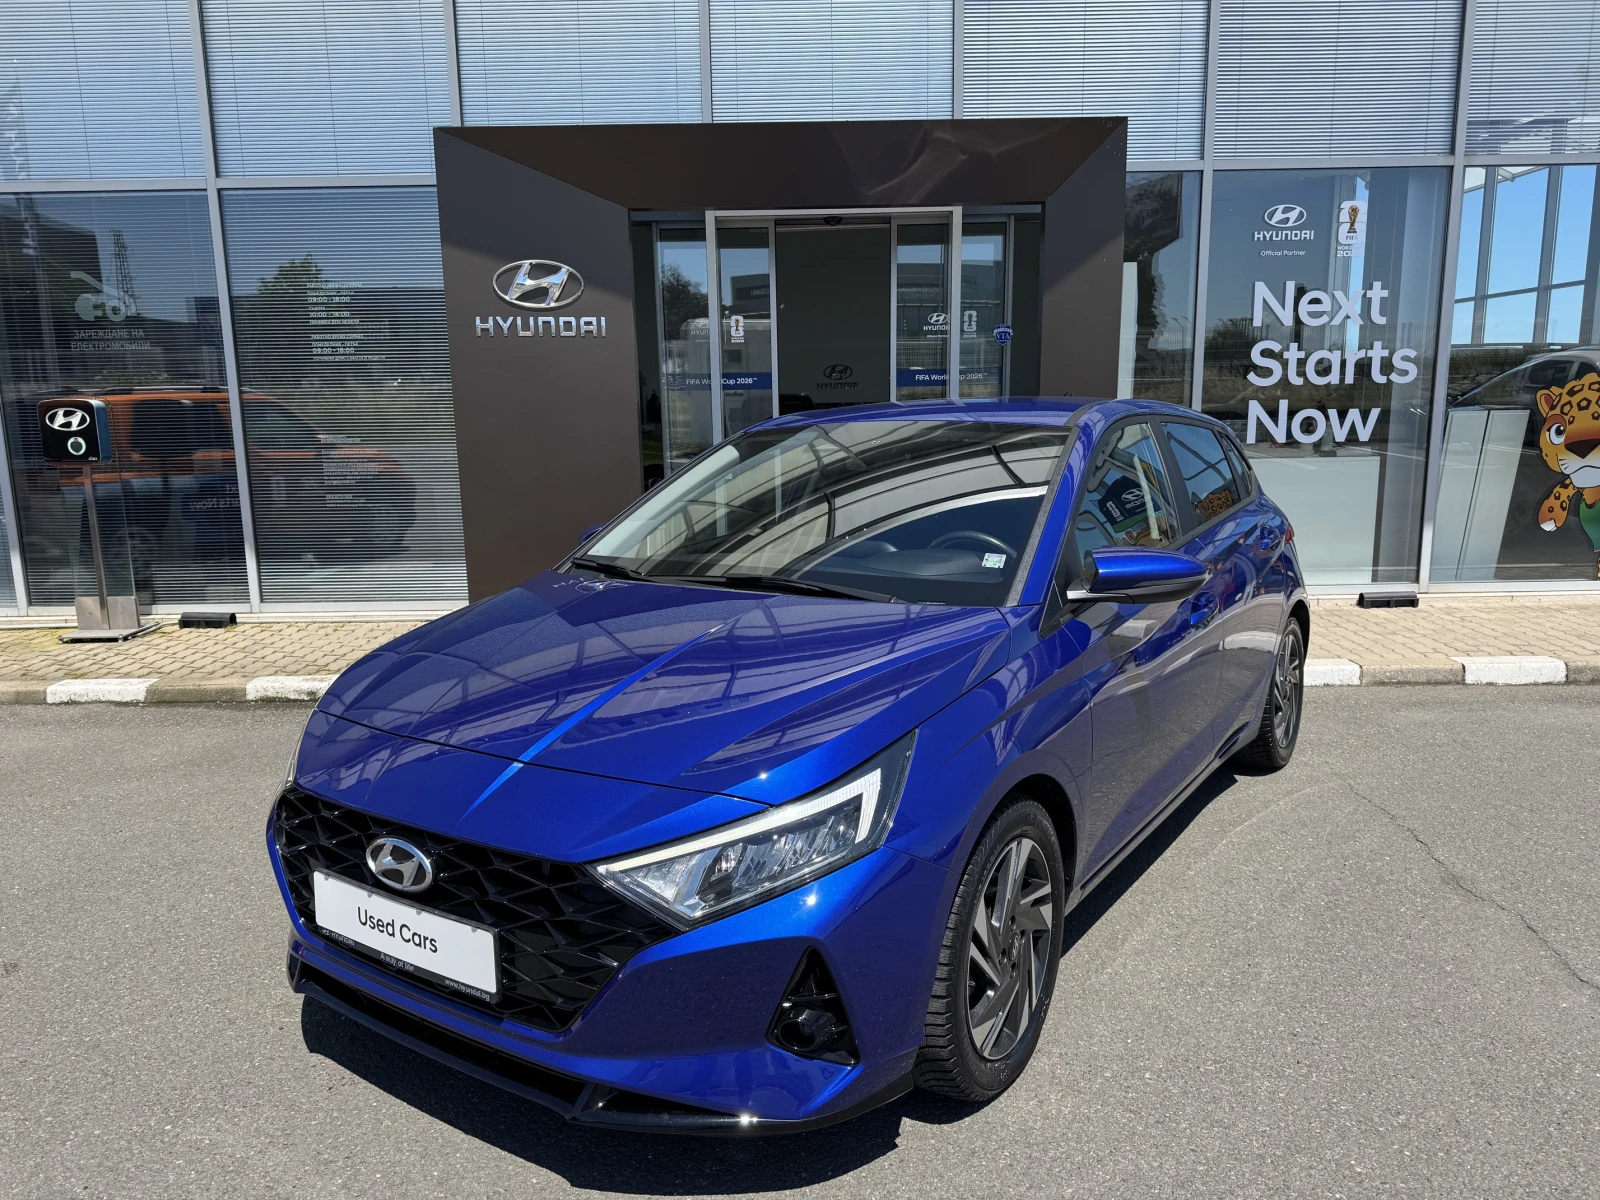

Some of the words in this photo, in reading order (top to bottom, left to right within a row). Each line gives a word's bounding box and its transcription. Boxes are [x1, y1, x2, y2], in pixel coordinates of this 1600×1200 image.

[1254, 230, 1315, 241] HYUNDAI
[1252, 280, 1389, 327] Next
[73, 328, 130, 339] ЗАРЕЖДАНЕ
[131, 328, 145, 338] НА
[475, 316, 607, 338] HYUNDAI
[71, 340, 151, 351] ЕЛЕКТРОМОБИЛИ
[1246, 339, 1418, 387] Starts
[722, 378, 736, 386] Cup
[816, 381, 860, 390] HYUNDAI
[1246, 399, 1382, 444] Now
[357, 906, 396, 939] Used
[399, 923, 438, 954] Cars
[380, 952, 385, 960] A
[386, 955, 396, 967] way
[397, 959, 404, 968] of
[405, 961, 414, 972] life
